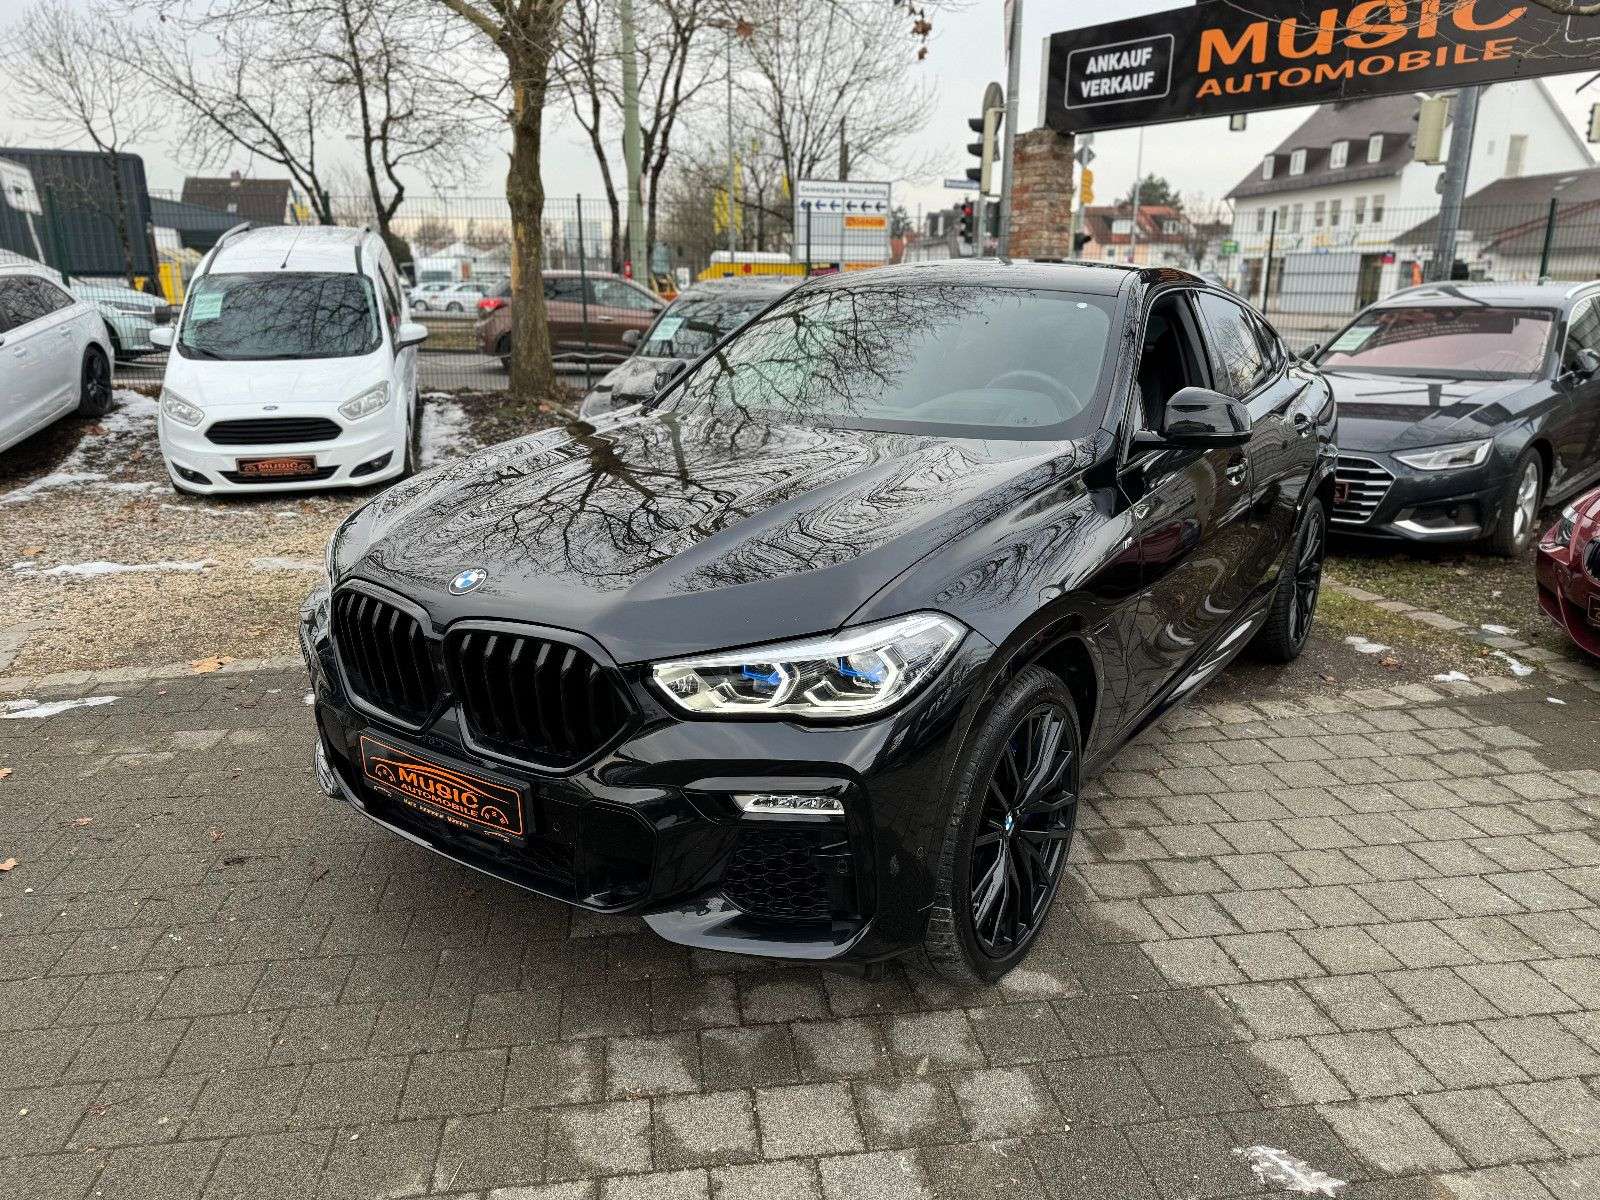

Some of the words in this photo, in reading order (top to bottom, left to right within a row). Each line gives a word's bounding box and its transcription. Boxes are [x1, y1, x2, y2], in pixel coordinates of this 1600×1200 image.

[1198, 0, 1528, 73] MUSIC
[1085, 47, 1153, 75] ANKAUF
[1196, 36, 1520, 98] AUTOMOBILE
[1080, 70, 1155, 99] VERKAUF
[398, 767, 479, 808] MUSIC
[400, 783, 479, 818] AUTOMOBILE
